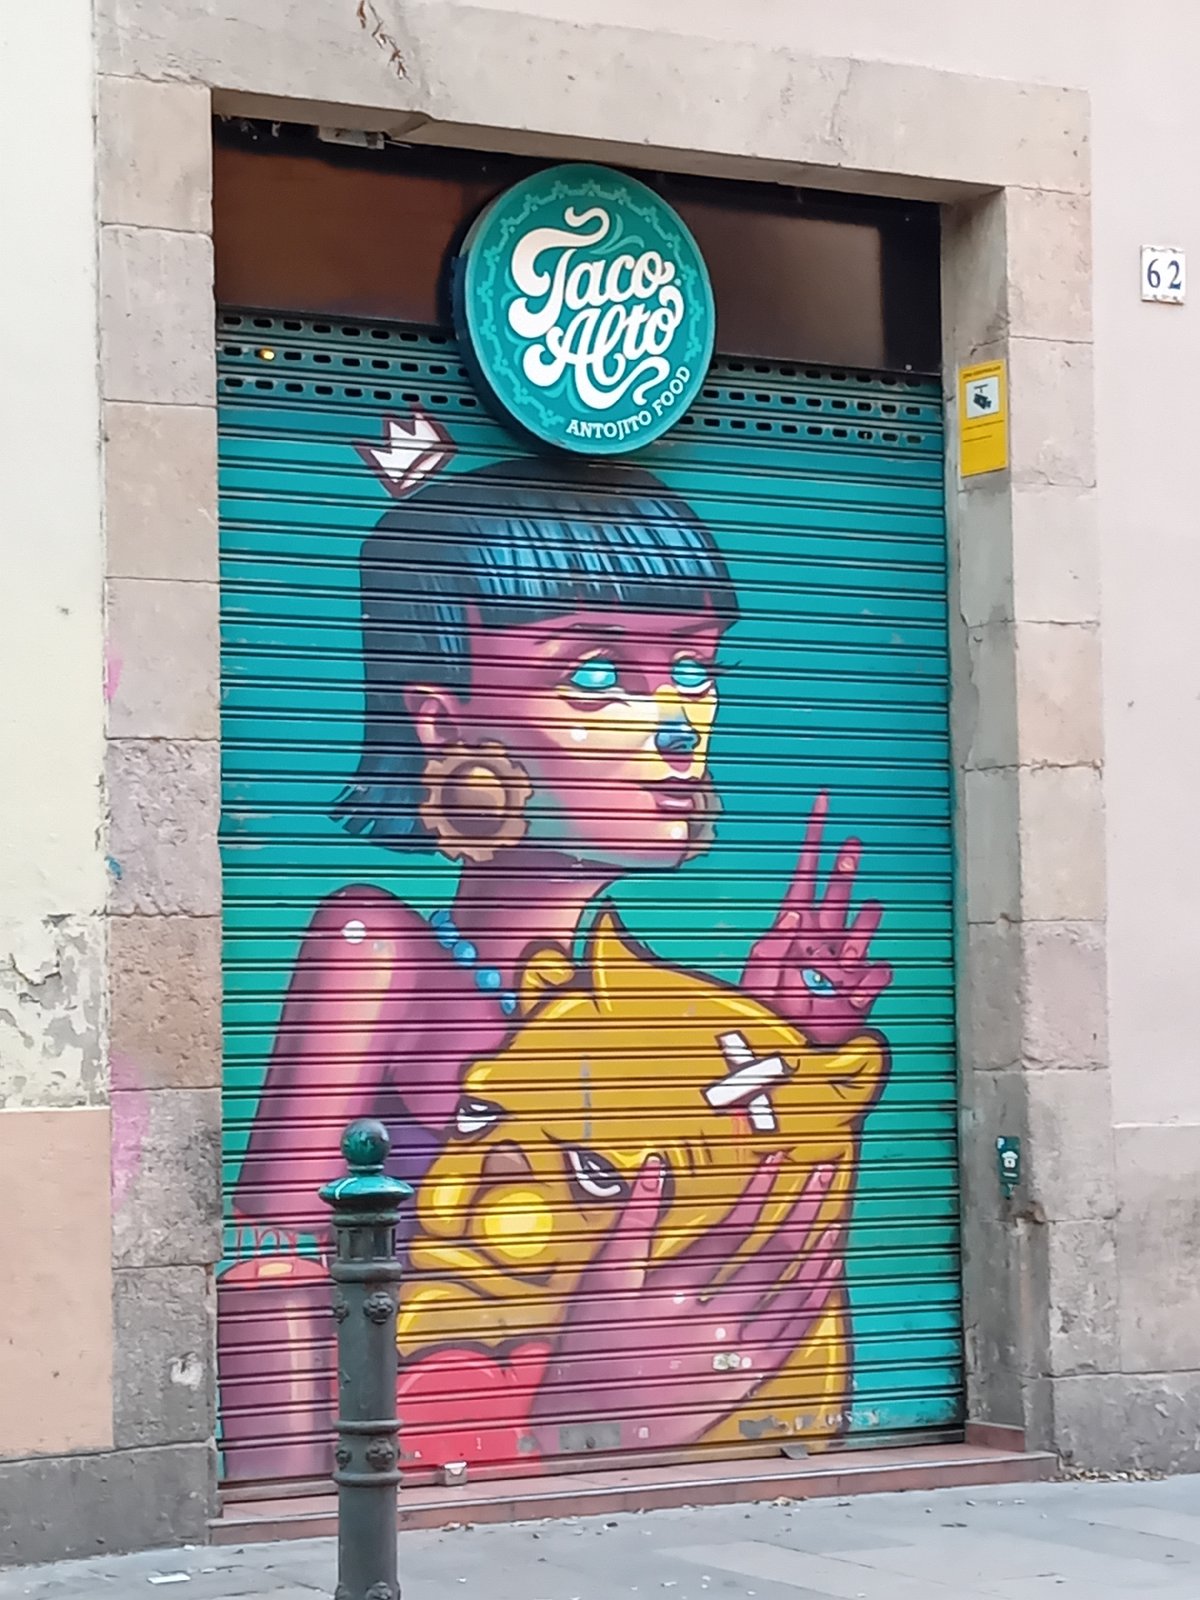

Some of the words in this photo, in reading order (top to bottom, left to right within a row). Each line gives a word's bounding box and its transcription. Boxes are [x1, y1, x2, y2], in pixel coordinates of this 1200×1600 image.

[508, 206, 675, 338] Taco
[1147, 258, 1182, 290] 62
[523, 286, 684, 409] Alto
[566, 410, 652, 441] ANTOJITO
[652, 366, 690, 416] FOOD
